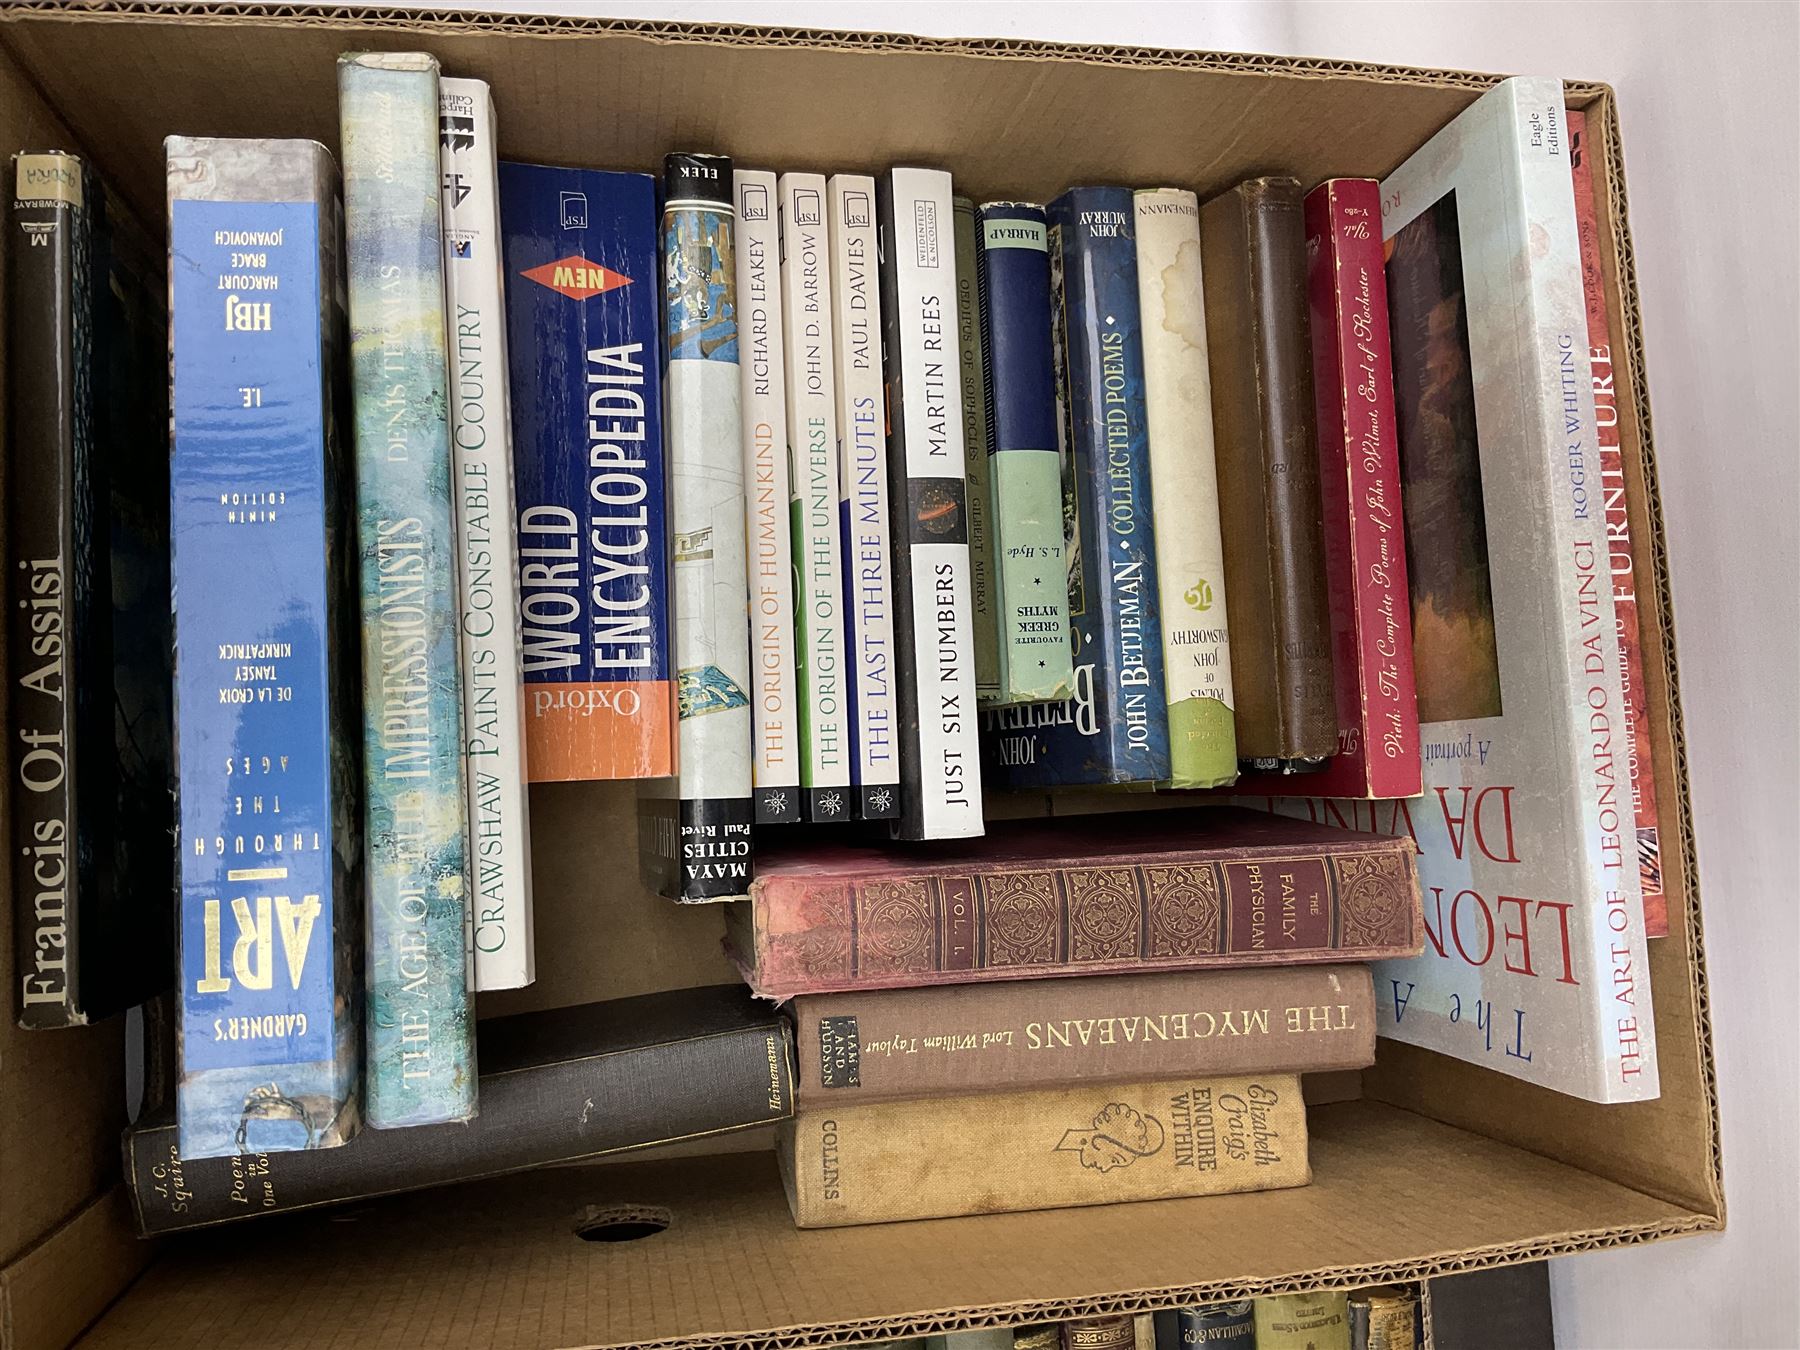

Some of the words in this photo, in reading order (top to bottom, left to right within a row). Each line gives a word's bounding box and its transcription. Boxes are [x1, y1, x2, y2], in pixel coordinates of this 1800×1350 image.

[1529, 112, 1542, 147] Eagle
[1548, 105, 1560, 156] Editions
[681, 167, 717, 179] ELEK
[14, 200, 69, 210] MOWBRAYS
[565, 216, 585, 226] TSP
[747, 207, 766, 217] TSP
[799, 212, 817, 222] TSP
[849, 215, 867, 224] TSP
[1079, 211, 1127, 225] MURRAY
[215, 229, 283, 246] JOVANOVICH
[917, 205, 927, 262] WEIDENFELD
[927, 206, 937, 255] NICOLSON
[990, 229, 1040, 241] HARRAP
[1090, 225, 1119, 238] JOHN
[1343, 221, 1370, 240] Yale
[218, 275, 278, 290] HARCOURT
[231, 253, 267, 268] BRACE
[553, 267, 604, 289] NEW
[749, 237, 767, 302] LEAKEY
[802, 233, 819, 312] BARROW
[848, 237, 866, 311] DAVIES
[225, 294, 272, 331] HBJ
[805, 320, 820, 337] D.
[922, 295, 942, 352] REES
[959, 279, 972, 344] OEDIPUS
[1352, 267, 1374, 342] Rochester
[751, 308, 769, 396] RICHARD
[853, 319, 869, 369] PAUL
[964, 350, 974, 370] OF
[1358, 343, 1378, 362] of
[456, 304, 486, 450] COUNTRY
[807, 345, 824, 397] JOHN
[1101, 332, 1127, 405] POEMS
[1358, 364, 1377, 403] Earl
[1558, 334, 1580, 436] WHITING
[238, 387, 261, 407] I.E.
[926, 362, 947, 457] MARTIN
[964, 377, 978, 462] SOPHOCLES
[388, 383, 408, 463] DENIS
[1362, 409, 1382, 473] Wilmot,
[808, 417, 829, 528] UNIVERSE
[854, 397, 880, 524] MINUTES
[1105, 409, 1135, 535] COLLECTED
[1566, 440, 1588, 520] ROGER
[1588, 344, 1635, 603] FURNITURE
[221, 492, 285, 505] EDITION
[229, 511, 276, 523] NINTH
[587, 343, 651, 669] ENCYCLOPEDIA
[755, 423, 777, 577] HUMANKIND
[1365, 479, 1392, 517] John
[973, 498, 984, 553] GILBERT
[1369, 514, 1391, 533] of
[463, 462, 495, 637] CONSTABLE
[814, 536, 831, 585] THE
[1007, 547, 1035, 559] Hyde
[1039, 548, 1050, 557] S.
[1052, 548, 1060, 558] L.
[1367, 538, 1391, 588] Poems
[521, 505, 581, 673] WORLD
[760, 586, 778, 616] OF
[861, 534, 884, 625] THREE
[975, 561, 987, 615] MURRAY
[1574, 540, 1601, 630] VINCI
[815, 589, 833, 619] OF
[935, 564, 959, 683] NUMBERS
[1017, 605, 1059, 617] MYTHS
[1018, 622, 1060, 633] GREEK
[1112, 560, 1150, 687] BETJEMAN
[1376, 593, 1402, 657] Complete
[19, 556, 64, 701] Assisi
[219, 643, 292, 659] KIRKPATRICK
[377, 517, 430, 779] IMPRESSIONISTS
[1015, 636, 1064, 645] FAVOURITE
[235, 666, 277, 681] TANSEY
[761, 624, 783, 713] ORIGIN
[817, 628, 836, 714] ORIGIN
[865, 635, 887, 697] LAST
[1194, 652, 1220, 668] JOHN
[1204, 673, 1214, 683] OF
[1583, 635, 1605, 675] DA
[1617, 645, 1630, 693] GUIDE
[219, 688, 254, 704] CROIX
[259, 688, 273, 702] LA
[278, 688, 292, 702] DE
[469, 649, 499, 758] PAINTS
[534, 689, 640, 717] Oxford
[1378, 658, 1399, 701] The
[867, 709, 889, 766] THE
[941, 694, 961, 734] SIX
[1127, 695, 1149, 751] JOHN
[1384, 709, 1404, 758] Vieth:
[20, 728, 64, 793] Of
[226, 755, 289, 776] AGES
[765, 720, 783, 768] THE
[820, 723, 838, 769] THE
[1000, 735, 1037, 765] JOHN
[1426, 733, 1471, 767] portrait
[1478, 740, 1491, 766] A
[943, 748, 969, 807] JUST
[1587, 686, 1623, 870] LEONARDO
[235, 796, 281, 815] THE
[1433, 786, 1521, 863] DA
[195, 832, 320, 856] THROUGH
[681, 825, 716, 837] Rivet
[684, 841, 749, 859] CITIES
[725, 824, 750, 836] Paul
[475, 772, 506, 954] CRAWSHAW
[686, 862, 747, 879] MAYA
[23, 818, 68, 1008] Francis
[951, 891, 965, 935] VOL.
[1246, 864, 1266, 949] PHYSICIAN
[1279, 873, 1296, 942] FAMILY
[1310, 892, 1319, 916] THE
[1607, 890, 1630, 932] OF
[196, 895, 322, 993] ART
[400, 930, 428, 998] AGE
[1610, 942, 1635, 1005] ART
[215, 1013, 308, 1042] GARDNER'S
[923, 1033, 979, 1051] William
[982, 1030, 1014, 1046] Lord
[1024, 1008, 1271, 1051] MYCENAEANS
[1285, 1004, 1356, 1034] THE
[1448, 992, 1533, 1063] The
[400, 1009, 431, 1090] THE
[821, 1019, 833, 1086] HUDSON
[834, 1034, 845, 1069] AND
[847, 1019, 860, 1085] THAMS
[865, 1035, 918, 1056] Taylour
[1618, 1015, 1643, 1084] THE
[768, 1035, 782, 1111] Heinemann
[1171, 1092, 1194, 1167] WITHIN
[1193, 1087, 1217, 1171] ENQUIRE
[1219, 1094, 1250, 1160] Craig's
[1248, 1084, 1280, 1166] Elizabeth
[153, 1163, 167, 1180] C.
[168, 1145, 193, 1213] Squire
[245, 1163, 256, 1178] in
[822, 1120, 839, 1200] COLLINS
[155, 1182, 168, 1198] J.
[263, 1181, 276, 1207] One
[1199, 1329, 1207, 1344] &
